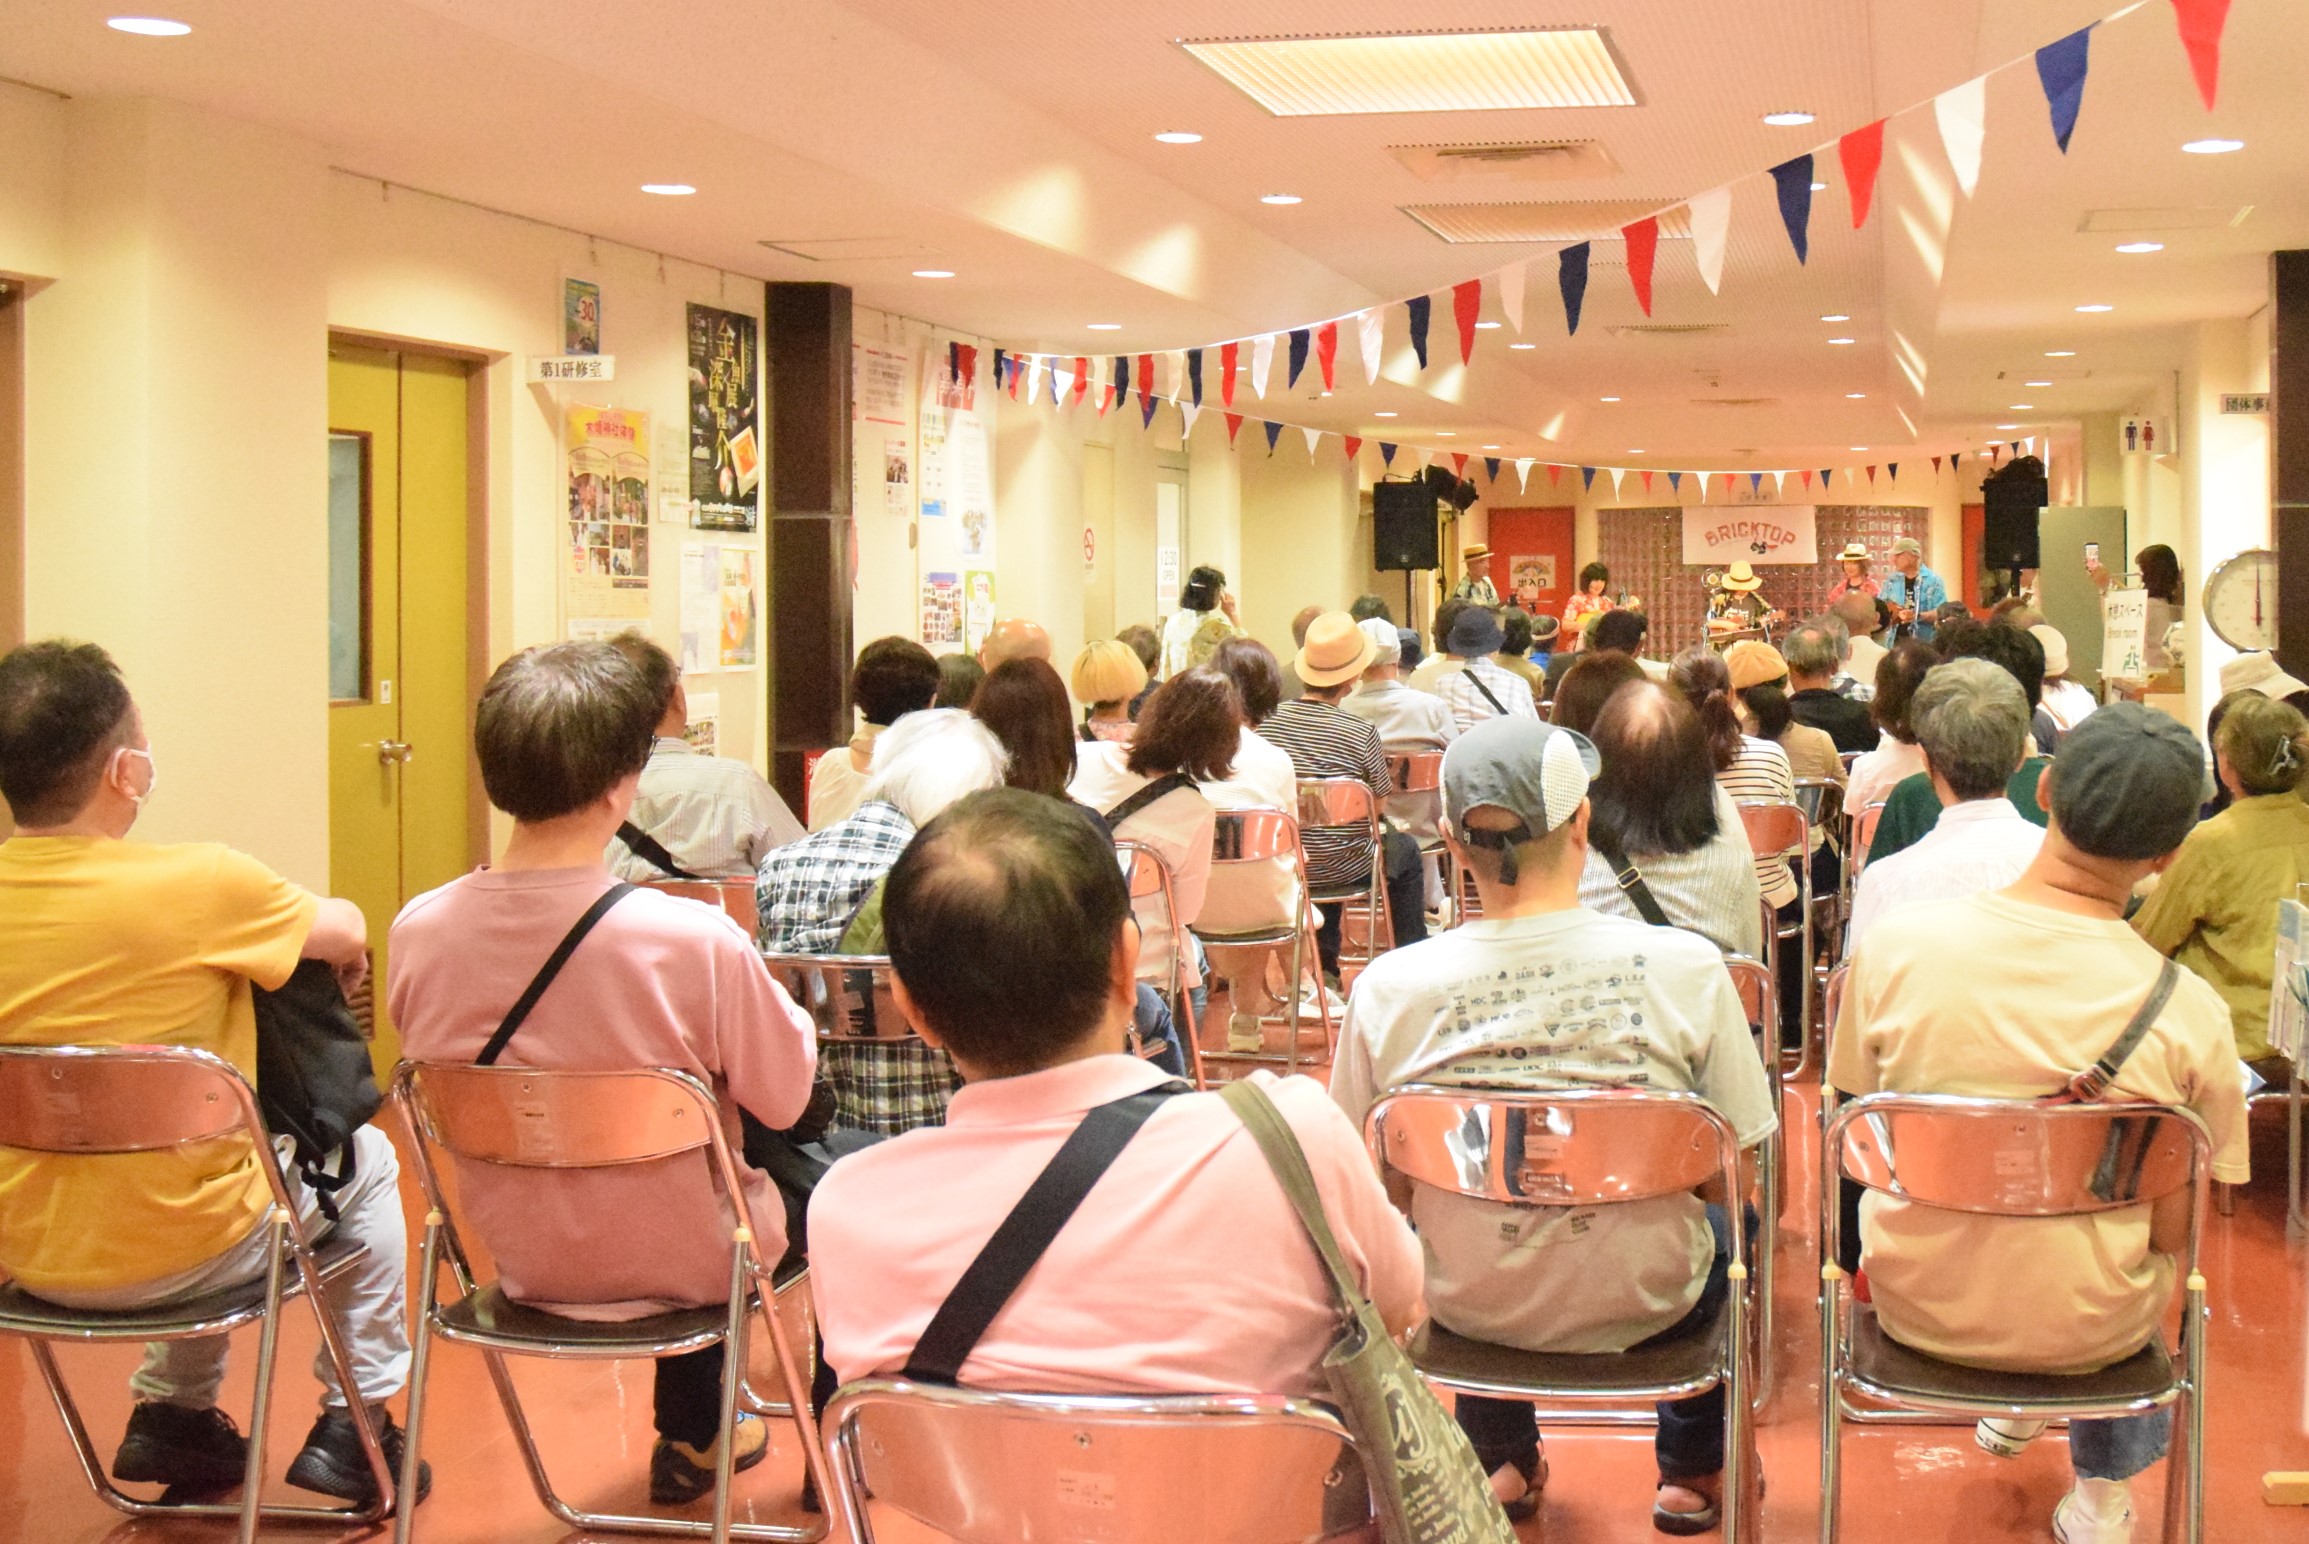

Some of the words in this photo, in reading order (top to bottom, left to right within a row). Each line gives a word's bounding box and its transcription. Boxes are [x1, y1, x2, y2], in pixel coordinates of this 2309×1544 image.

[540, 360, 602, 379] 第1研修室
[1704, 521, 1796, 547] BRICKTOP
[1517, 578, 1547, 588] 出入口
[1515, 970, 1535, 981] DASH
